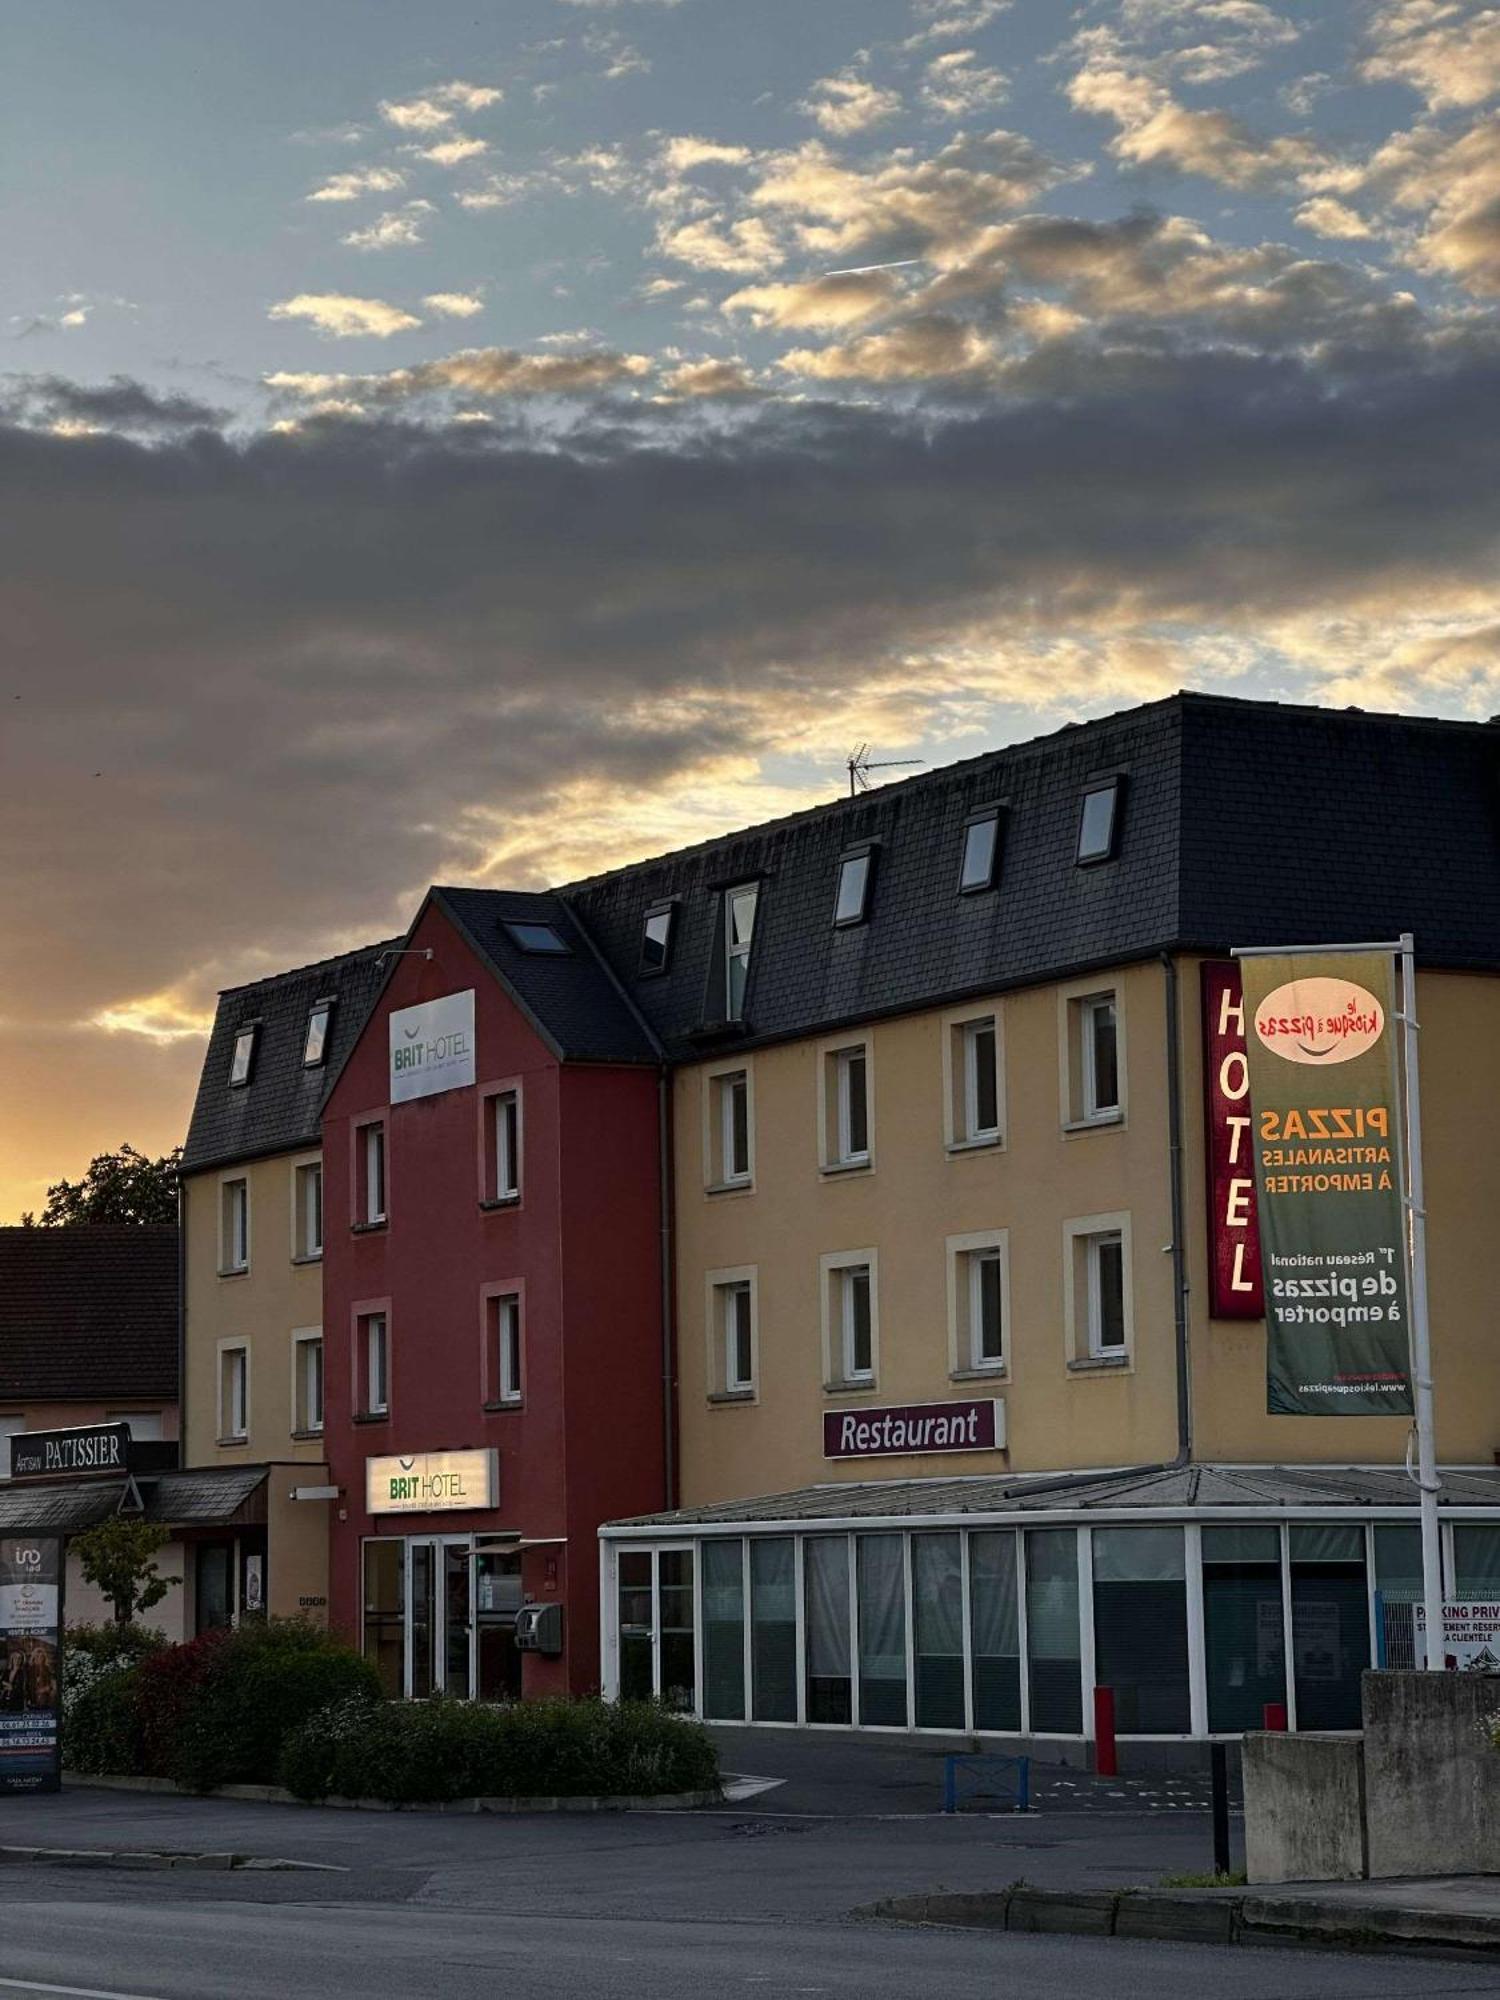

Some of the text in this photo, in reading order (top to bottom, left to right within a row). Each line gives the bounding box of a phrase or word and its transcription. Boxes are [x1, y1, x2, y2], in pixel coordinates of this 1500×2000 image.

[394, 1043, 424, 1070] BRIT
[426, 1032, 470, 1064] HOTEL
[1218, 989, 1253, 1291] HOTEL
[840, 1407, 978, 1450] Restaurant
[45, 1434, 120, 1469] PATISSIER
[389, 1473, 467, 1500] BRIT HOTEL
[1416, 1606, 1469, 1618] PKING
[1473, 1621, 1500, 1632] RÉSER
